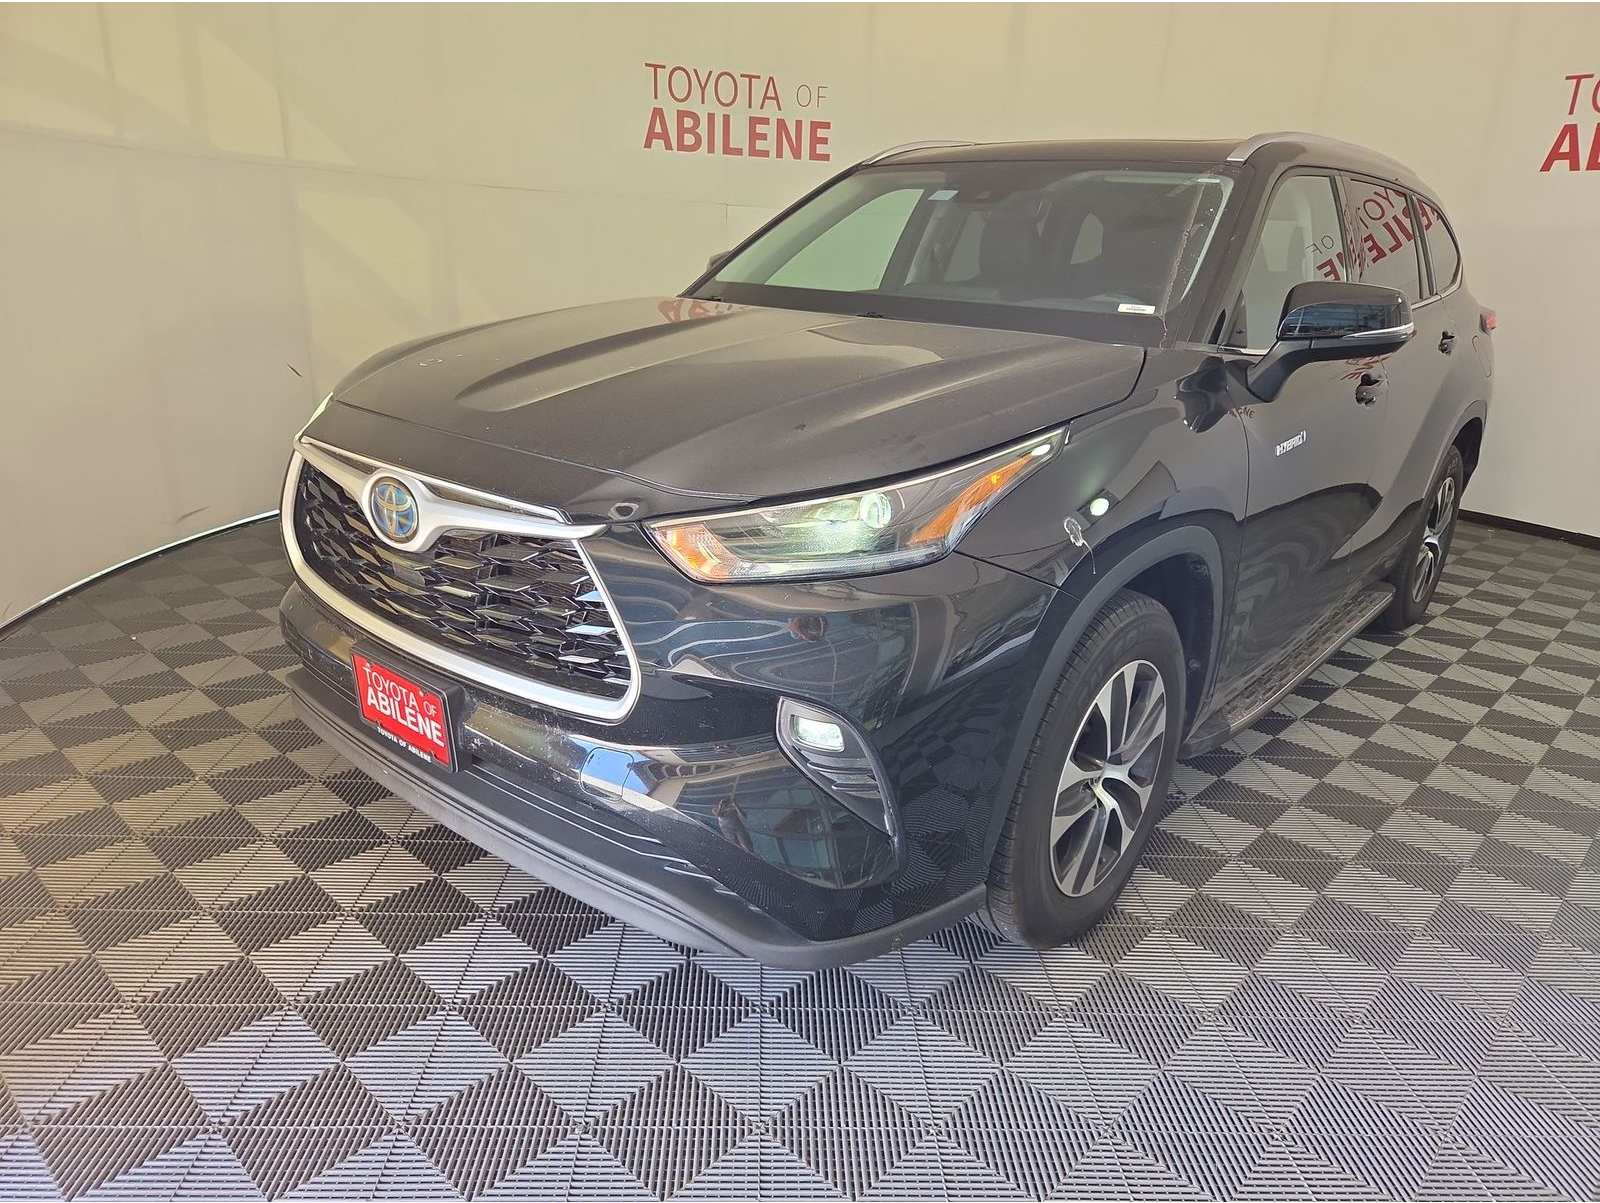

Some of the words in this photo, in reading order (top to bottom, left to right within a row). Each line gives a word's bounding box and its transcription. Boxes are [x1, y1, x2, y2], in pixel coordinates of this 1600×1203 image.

[645, 62, 782, 111] TOYOTA
[796, 84, 828, 108] OF
[643, 106, 832, 162] ABILENE
[362, 665, 420, 713] TOYOTA
[423, 700, 437, 717] OF
[367, 686, 445, 748] ABILENE
[376, 725, 398, 743] TOYOTA
[399, 739, 407, 748] OF
[408, 744, 432, 763] ABILENE
